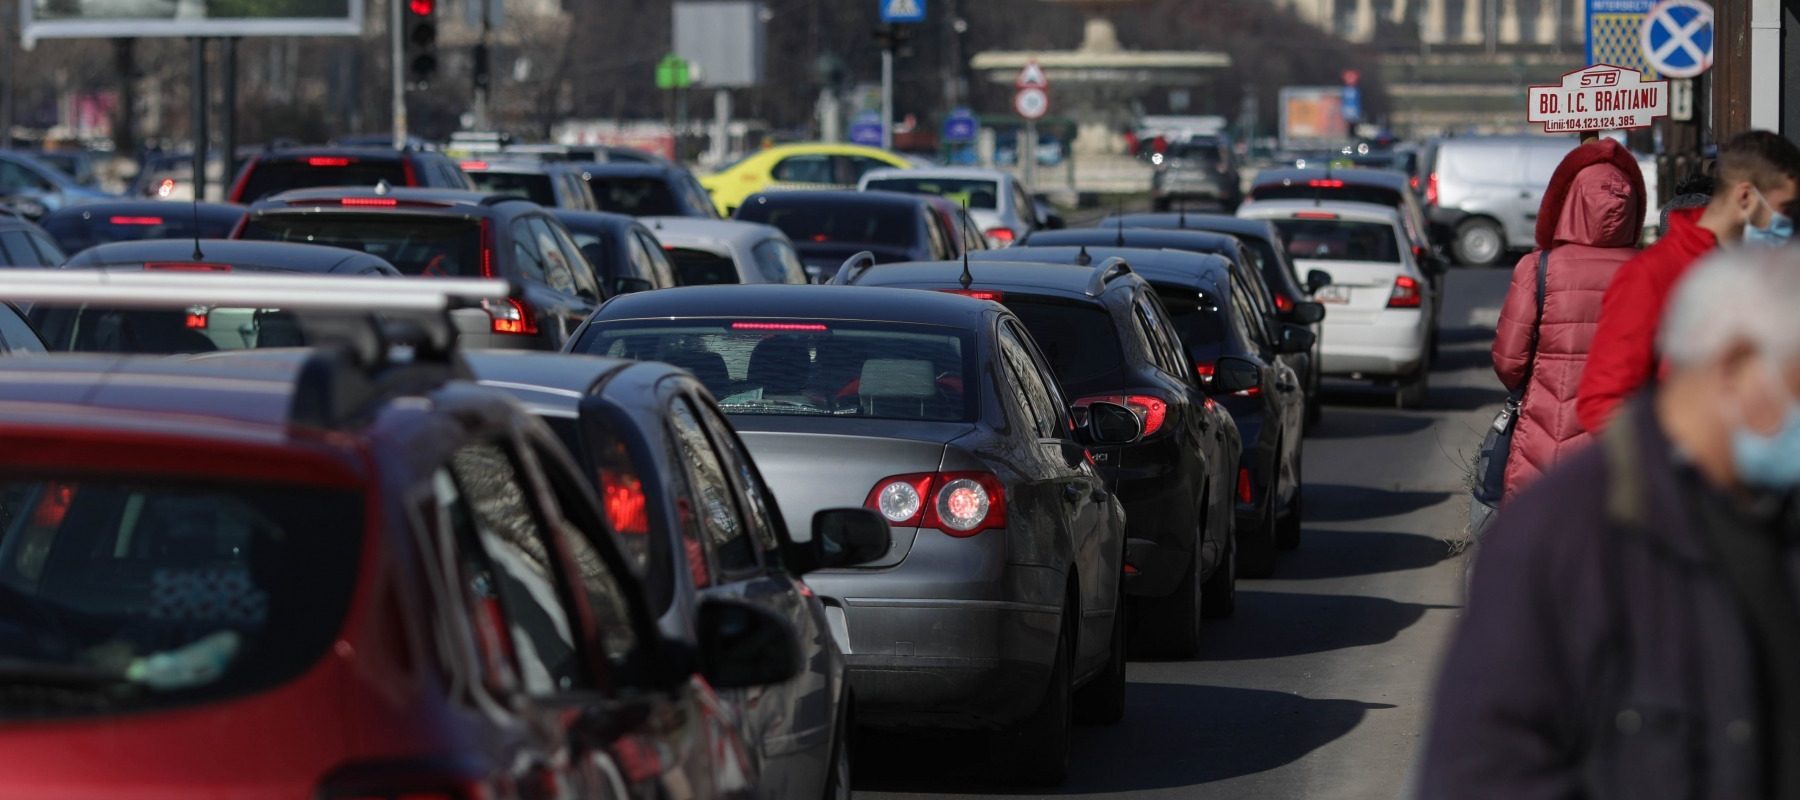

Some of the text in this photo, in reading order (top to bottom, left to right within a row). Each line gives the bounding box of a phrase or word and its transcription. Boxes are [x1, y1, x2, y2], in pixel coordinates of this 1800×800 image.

[1580, 72, 1617, 86] STB
[1540, 87, 1658, 114] BD. I.C. BRATIANU
